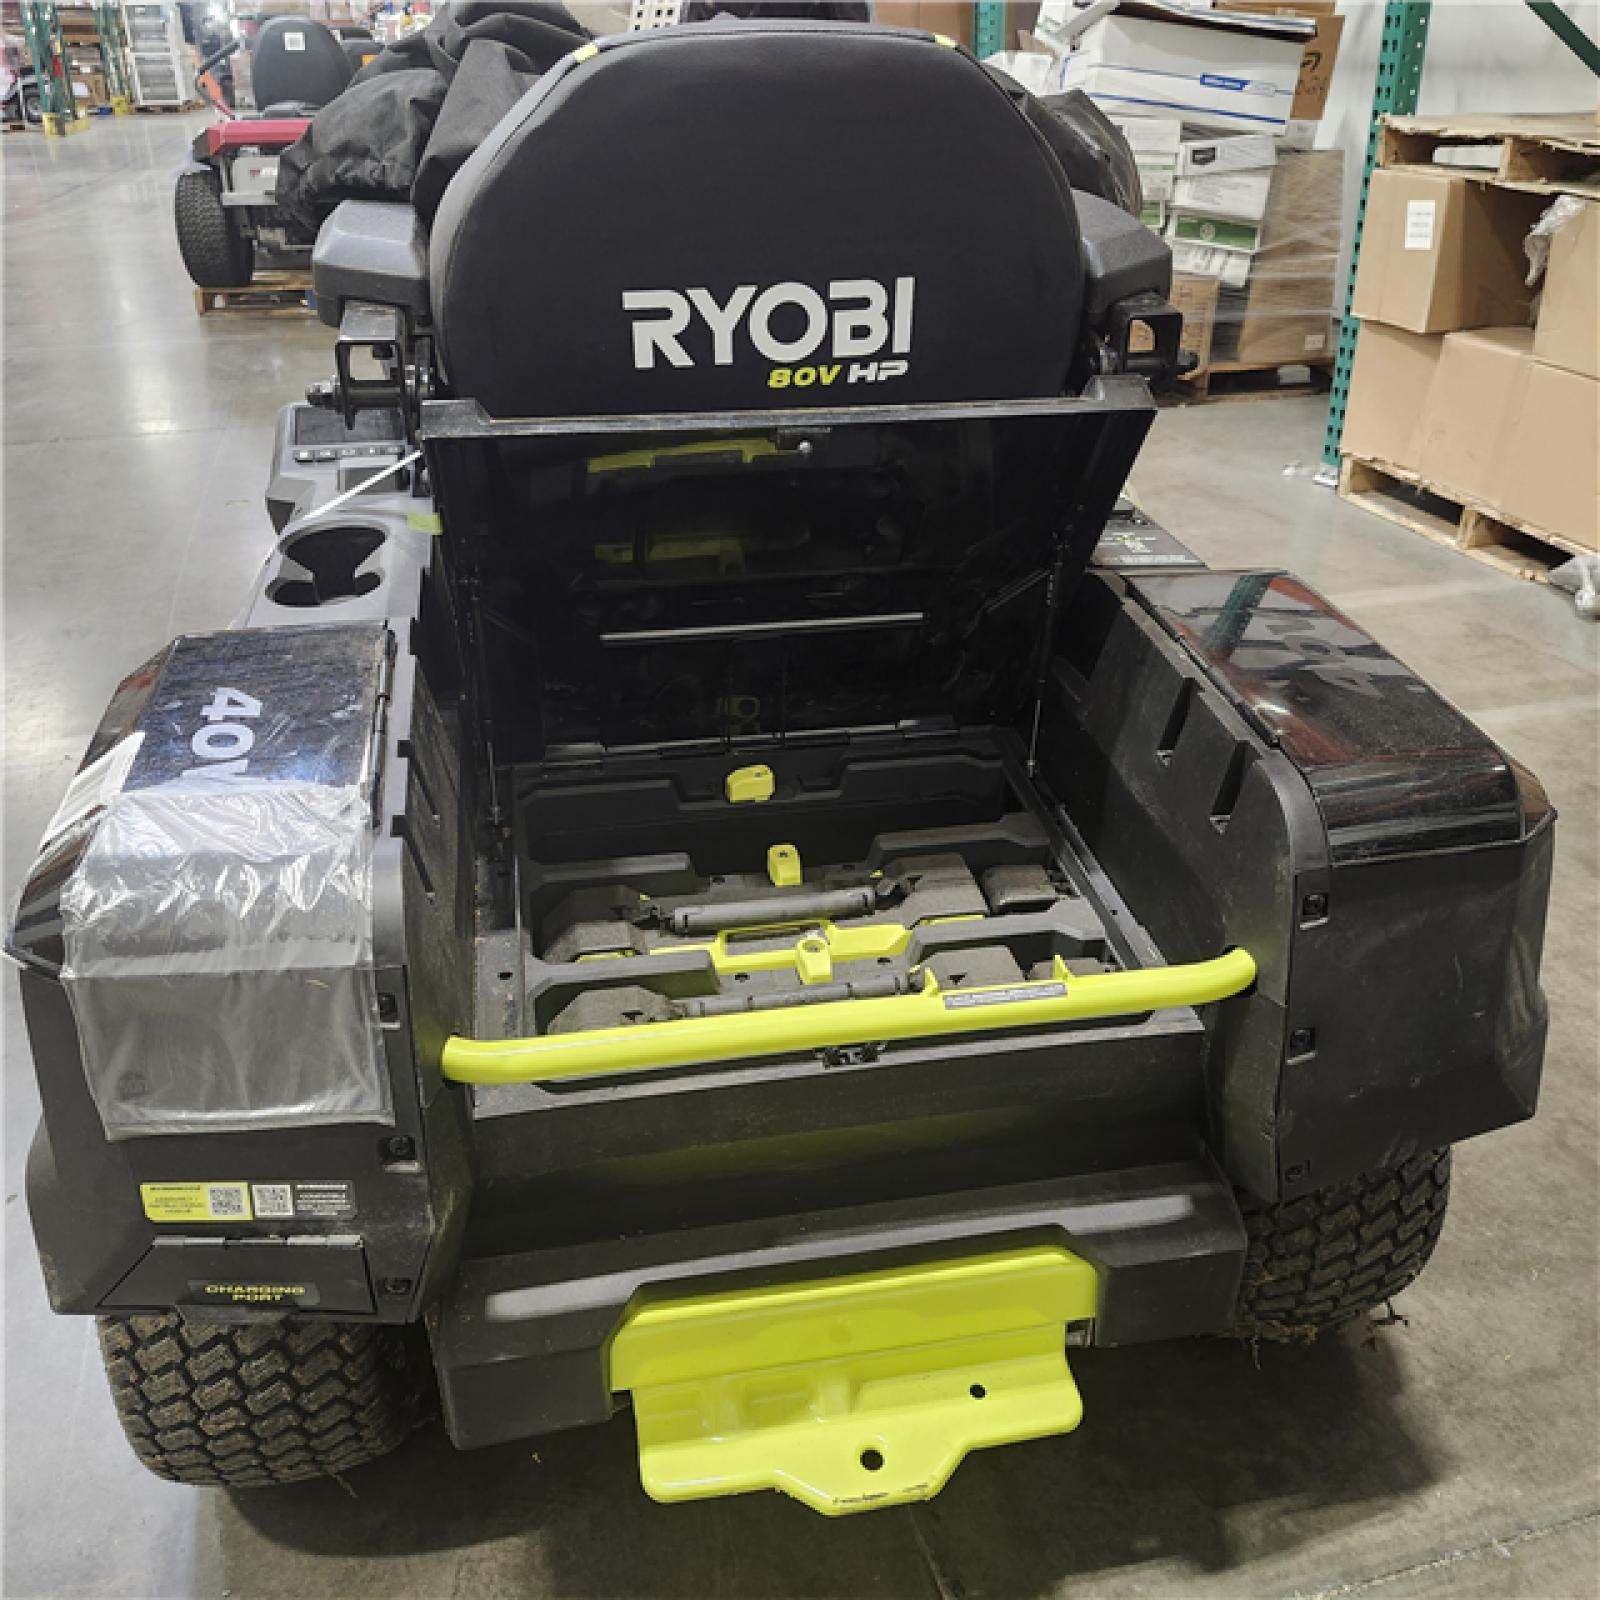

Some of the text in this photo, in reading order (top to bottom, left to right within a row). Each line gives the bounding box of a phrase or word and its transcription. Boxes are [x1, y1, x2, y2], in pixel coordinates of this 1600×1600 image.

[622, 277, 915, 368] RYOBI
[767, 360, 909, 388] 80V HP
